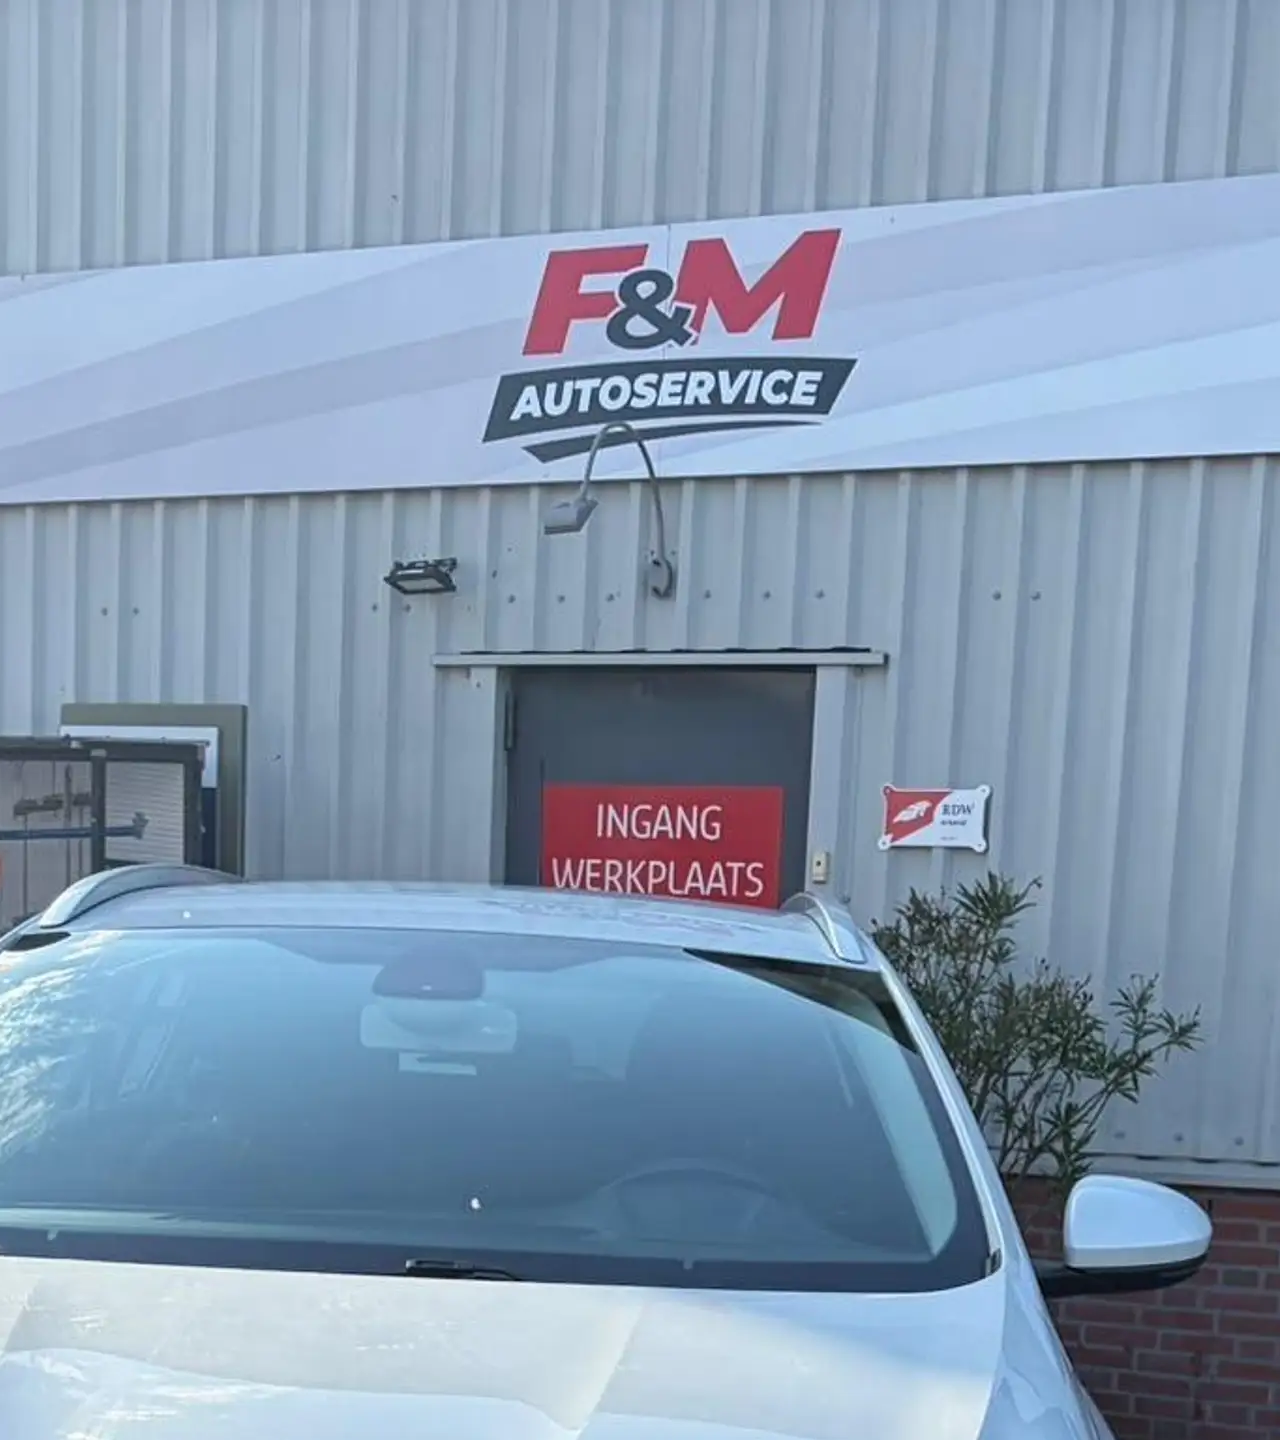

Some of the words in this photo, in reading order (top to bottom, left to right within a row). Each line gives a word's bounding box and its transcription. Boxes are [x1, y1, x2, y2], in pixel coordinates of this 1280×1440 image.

[523, 228, 842, 356] F&M
[510, 369, 822, 421] AUTOSERVICE
[596, 803, 723, 841] INGANG
[551, 856, 765, 898] WERKPLAATS
